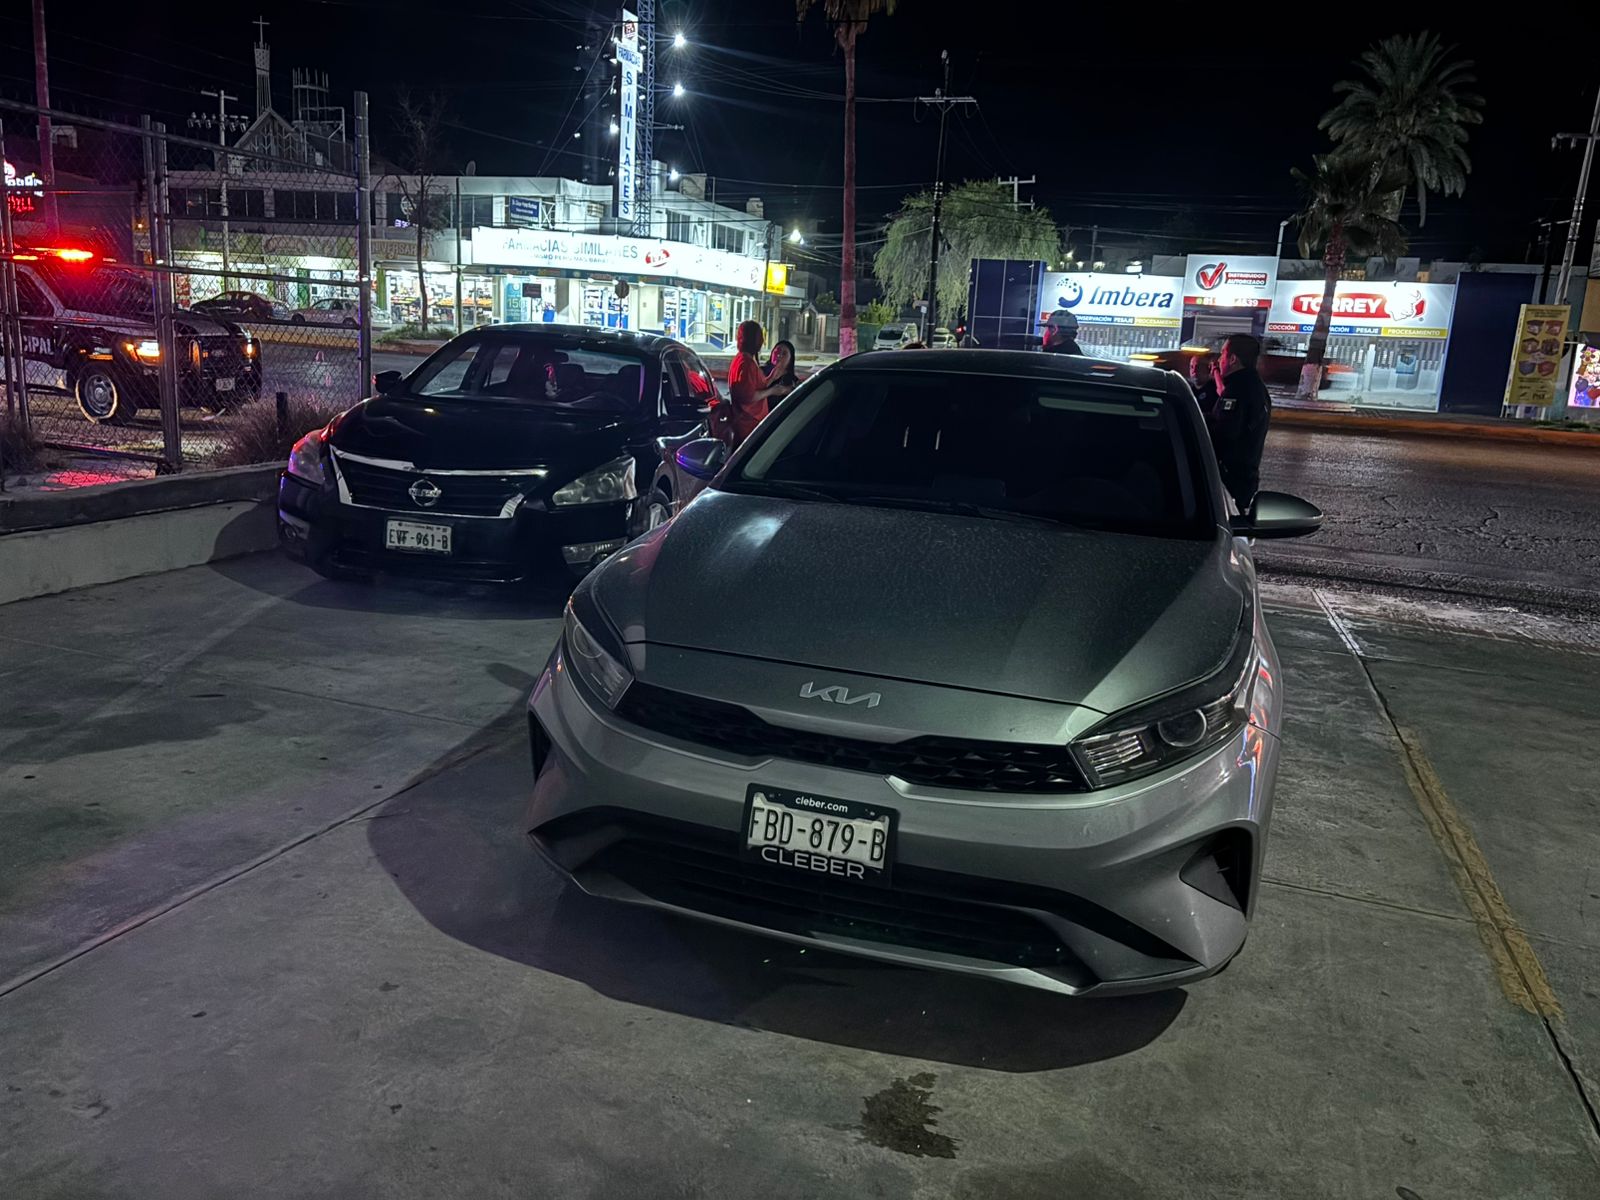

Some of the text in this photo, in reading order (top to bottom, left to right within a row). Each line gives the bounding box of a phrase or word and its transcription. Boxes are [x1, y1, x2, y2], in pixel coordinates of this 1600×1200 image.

[622, 71, 633, 215] SIMILARES
[1088, 286, 1174, 308] Imbera
[1299, 297, 1383, 314] TORREY
[1387, 328, 1441, 336] PROCESAMIENTO
[799, 681, 882, 708] KIA
[794, 795, 849, 813] cleber.com
[749, 806, 886, 862] FBD-879-B
[761, 847, 865, 880] CLEBER
